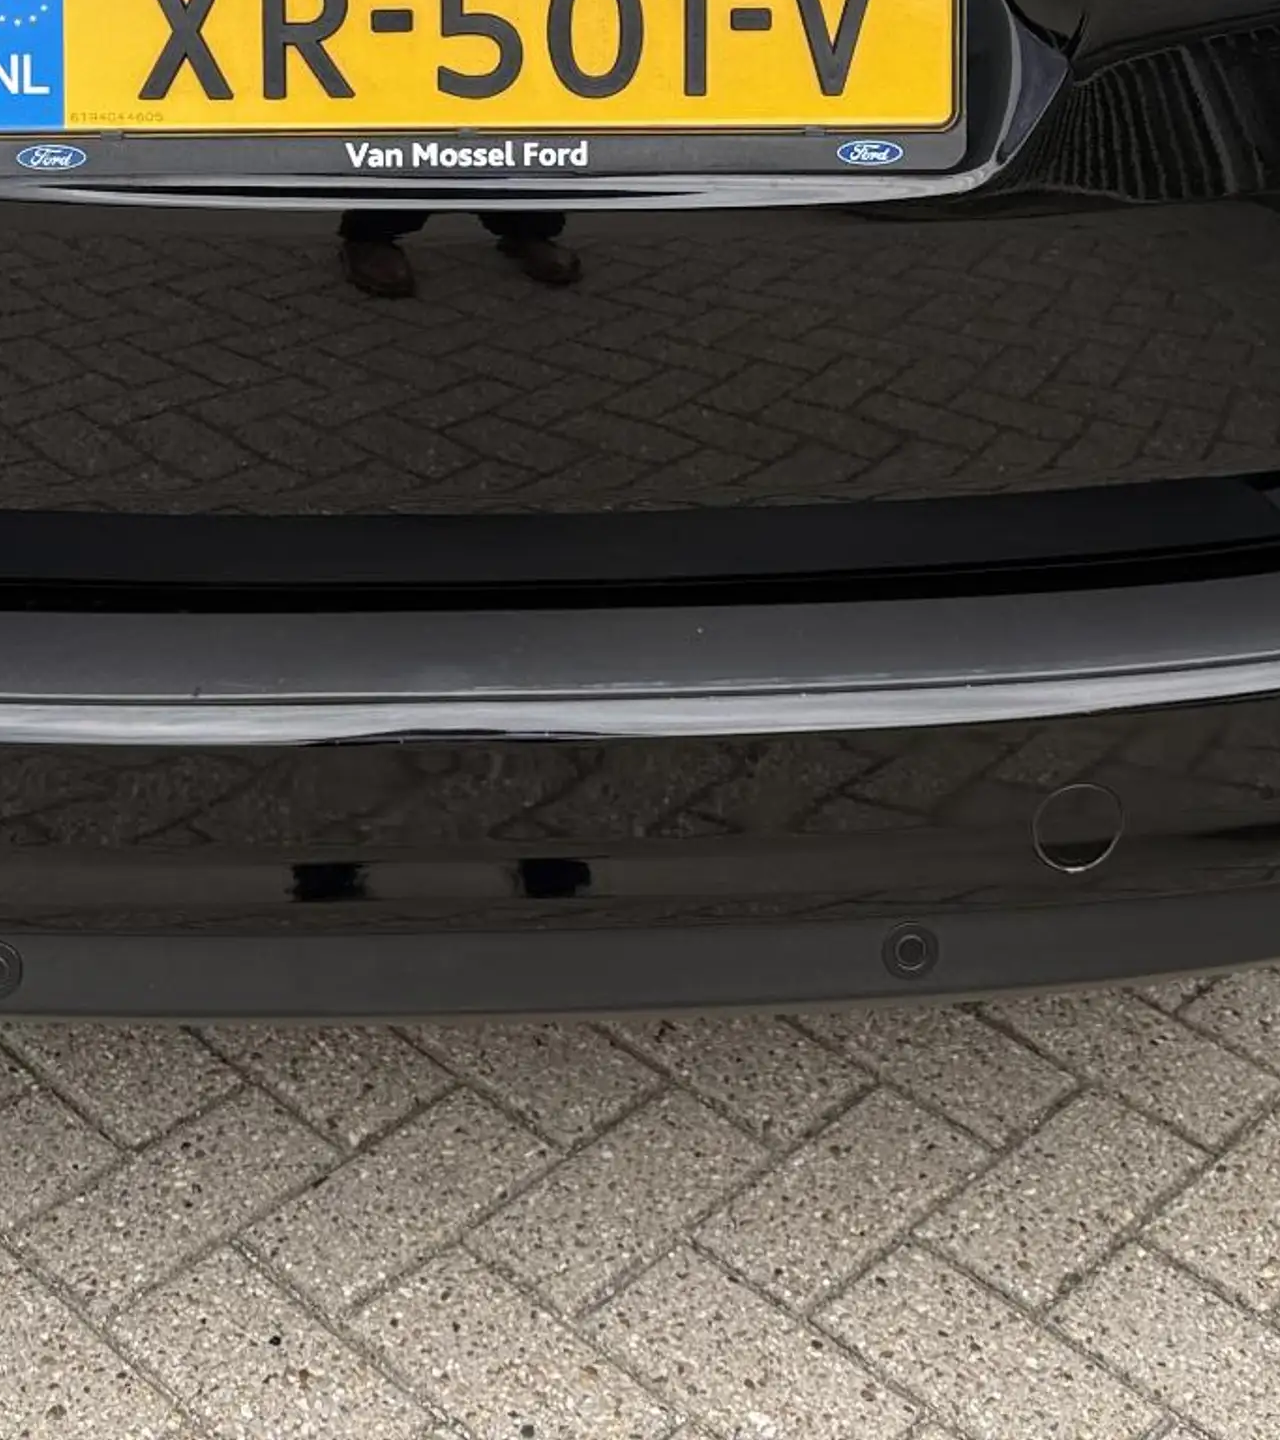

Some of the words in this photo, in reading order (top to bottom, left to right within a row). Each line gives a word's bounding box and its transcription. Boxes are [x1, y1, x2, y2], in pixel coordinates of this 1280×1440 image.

[30, 147, 74, 167] Ford
[345, 142, 404, 168] Van
[412, 140, 516, 168] Mossel
[523, 140, 589, 167] Ford
[849, 143, 891, 161] Ford
